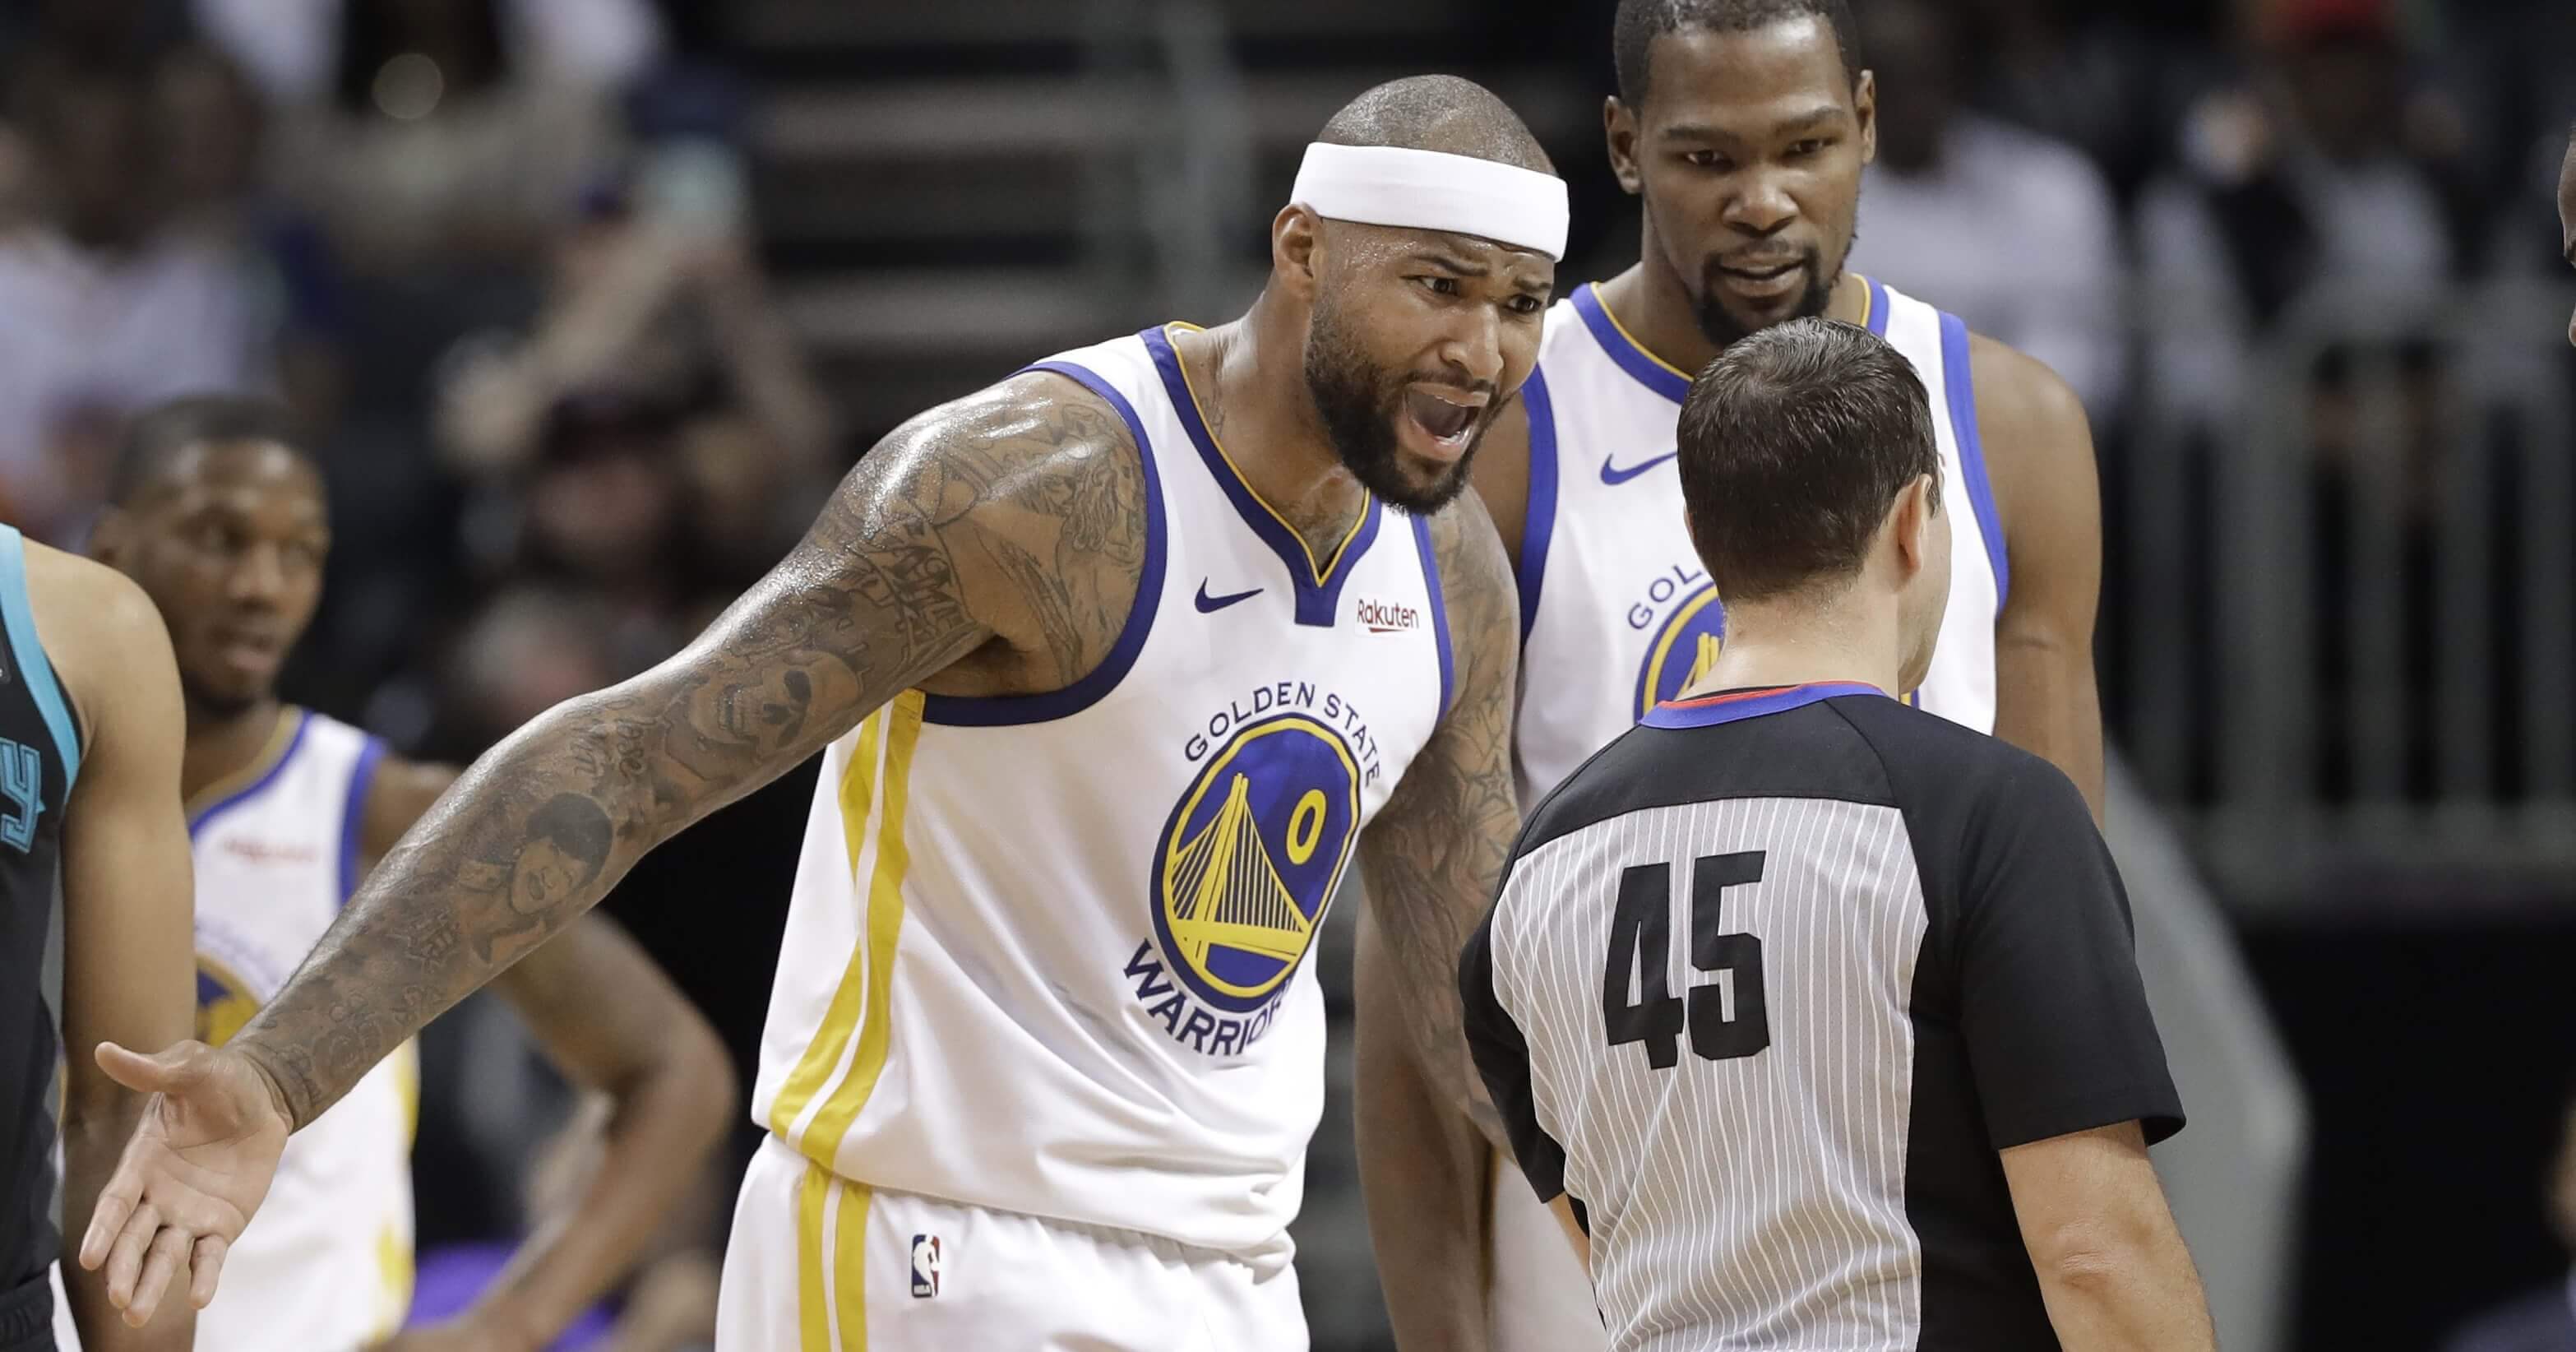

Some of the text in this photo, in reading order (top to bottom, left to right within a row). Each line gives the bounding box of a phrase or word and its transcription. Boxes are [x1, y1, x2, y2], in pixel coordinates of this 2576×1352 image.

[1357, 598, 1420, 629] Rakuten
[1185, 682, 1380, 788] GOLDEN STATE
[1286, 788, 1328, 866] 0
[1602, 850, 1771, 1071] 45
